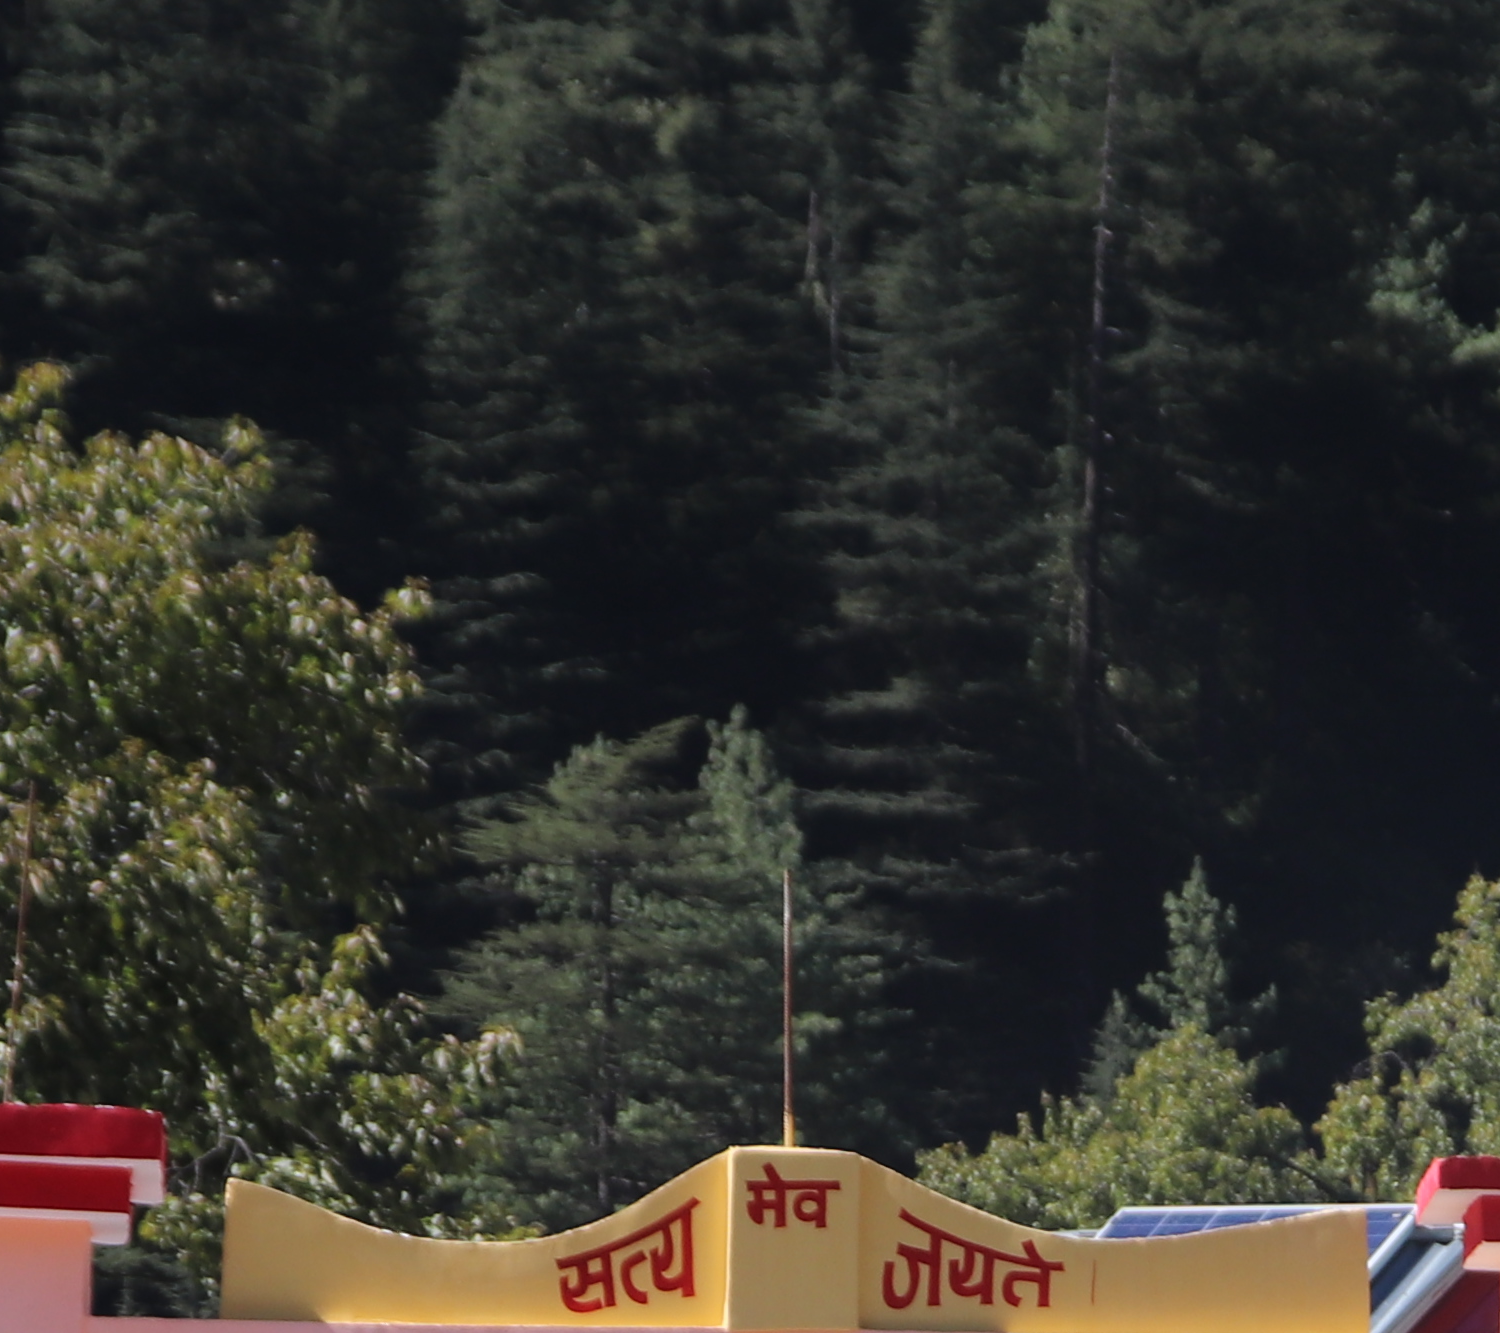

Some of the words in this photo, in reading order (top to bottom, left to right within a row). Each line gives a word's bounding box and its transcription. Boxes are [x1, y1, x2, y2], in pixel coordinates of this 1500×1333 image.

[555, 1197, 701, 1313] सत्य
[746, 1162, 840, 1228] मेव
[882, 1206, 1064, 1310] जयते
